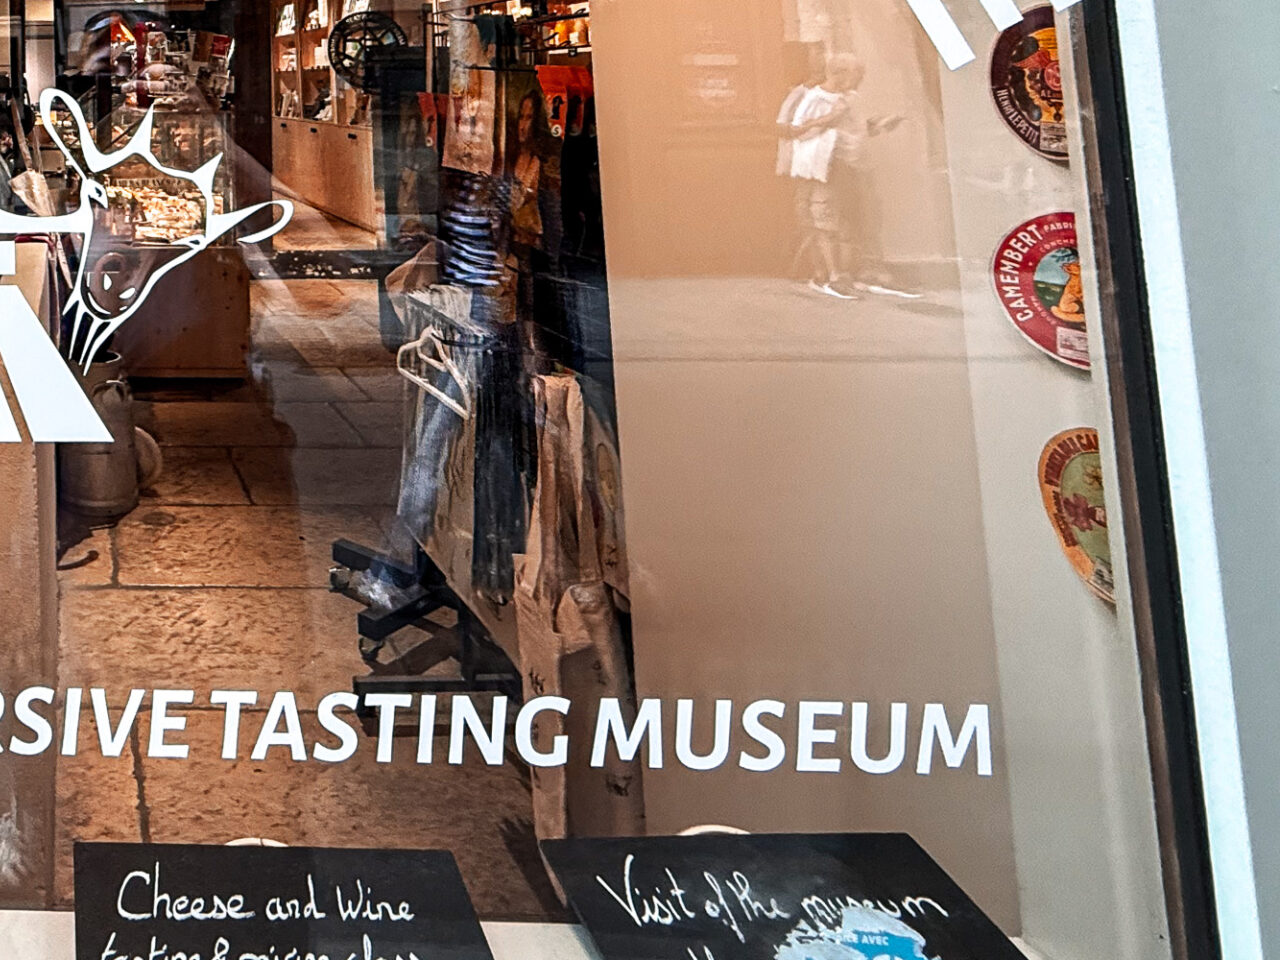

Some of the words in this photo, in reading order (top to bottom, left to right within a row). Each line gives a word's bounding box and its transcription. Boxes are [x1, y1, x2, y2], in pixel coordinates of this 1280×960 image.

[999, 223, 1043, 322] CAMEMBERT
[211, 690, 571, 767] TASTING
[590, 698, 992, 776] MUSEUM
[116, 860, 256, 922] Cheese
[265, 873, 327, 921] and
[335, 877, 416, 922] Wine
[596, 854, 696, 927] Visit
[861, 934, 889, 946] AVEC
